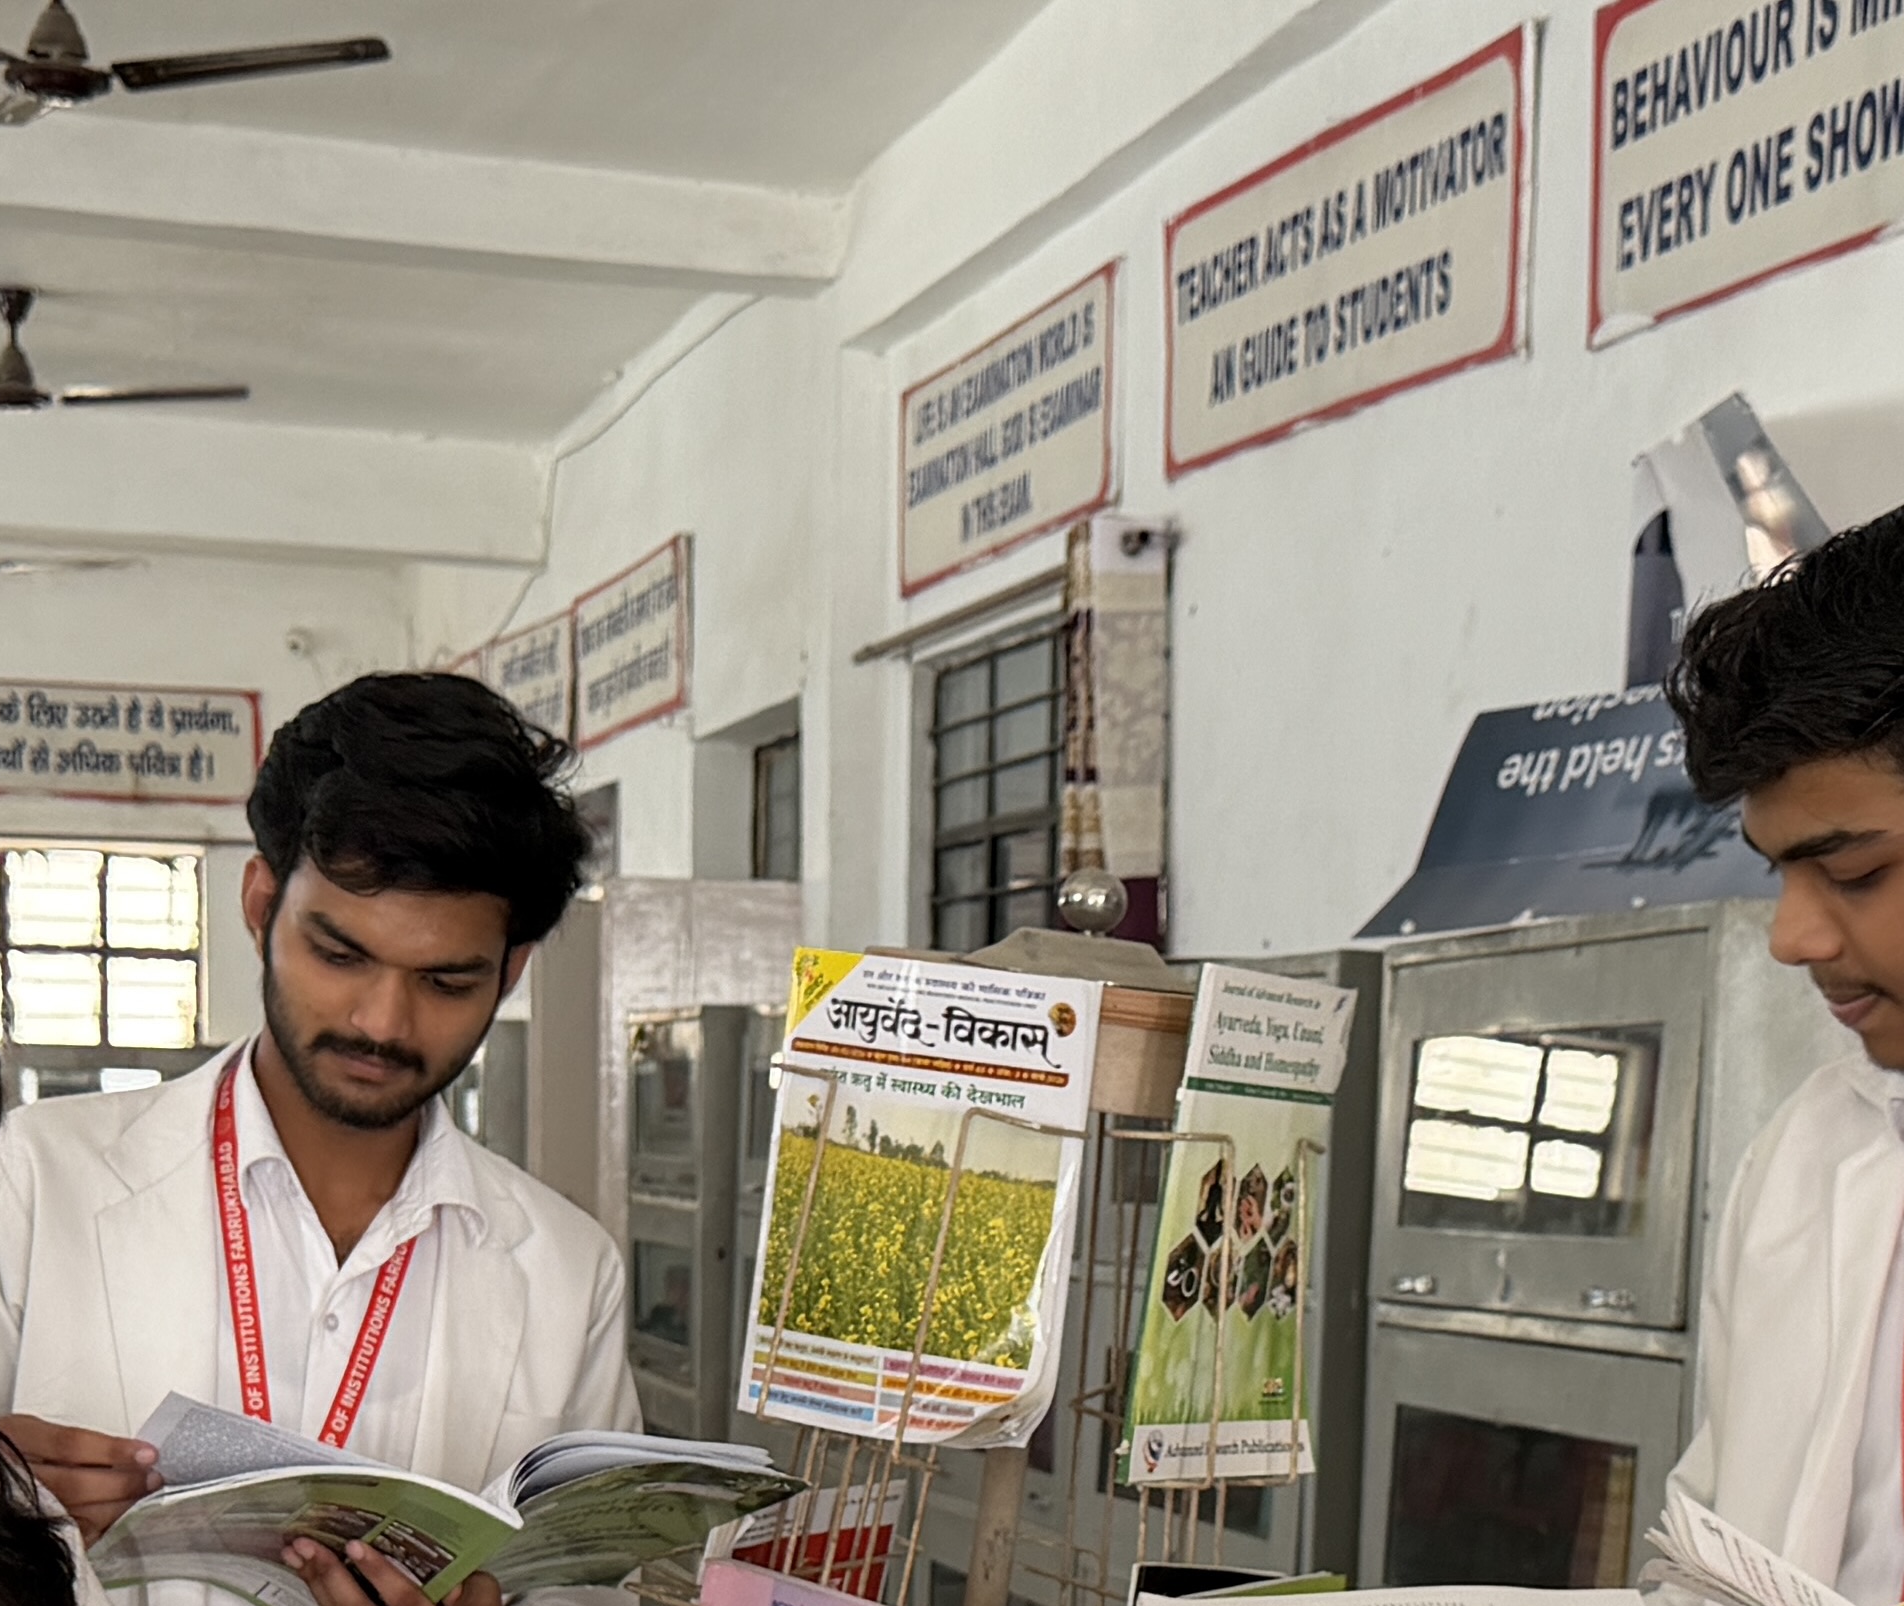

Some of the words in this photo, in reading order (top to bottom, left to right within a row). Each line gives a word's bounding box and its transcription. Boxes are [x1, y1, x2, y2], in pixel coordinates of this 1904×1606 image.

[1611, 6, 1793, 153] BEHAVIOUR
[1804, 0, 1837, 58] IS
[1178, 234, 1260, 326] TEACHER
[1262, 205, 1314, 284] ACTS
[1317, 190, 1346, 259] AS
[1350, 179, 1367, 244] A
[1372, 111, 1507, 233] MOTIVATOR
[1616, 162, 1718, 272] EVERY
[1727, 126, 1796, 227] ONE
[1209, 344, 1236, 409] AN
[1239, 316, 1298, 394] GUIDE
[1303, 302, 1329, 367] TO
[1334, 249, 1452, 355] STUDENTS
[1498, 750, 1554, 795] the
[1561, 731, 1645, 793] held
[942, 1081, 961, 1100] की
[967, 1084, 1025, 1109] देखभाल
[219, 1141, 248, 1261] FARRUKHABAD
[233, 1262, 259, 1387] INSTITUTIONS
[330, 1404, 349, 1432] OF
[342, 1295, 392, 1408] INSTITUTIONS
[247, 1389, 264, 1411] OF
